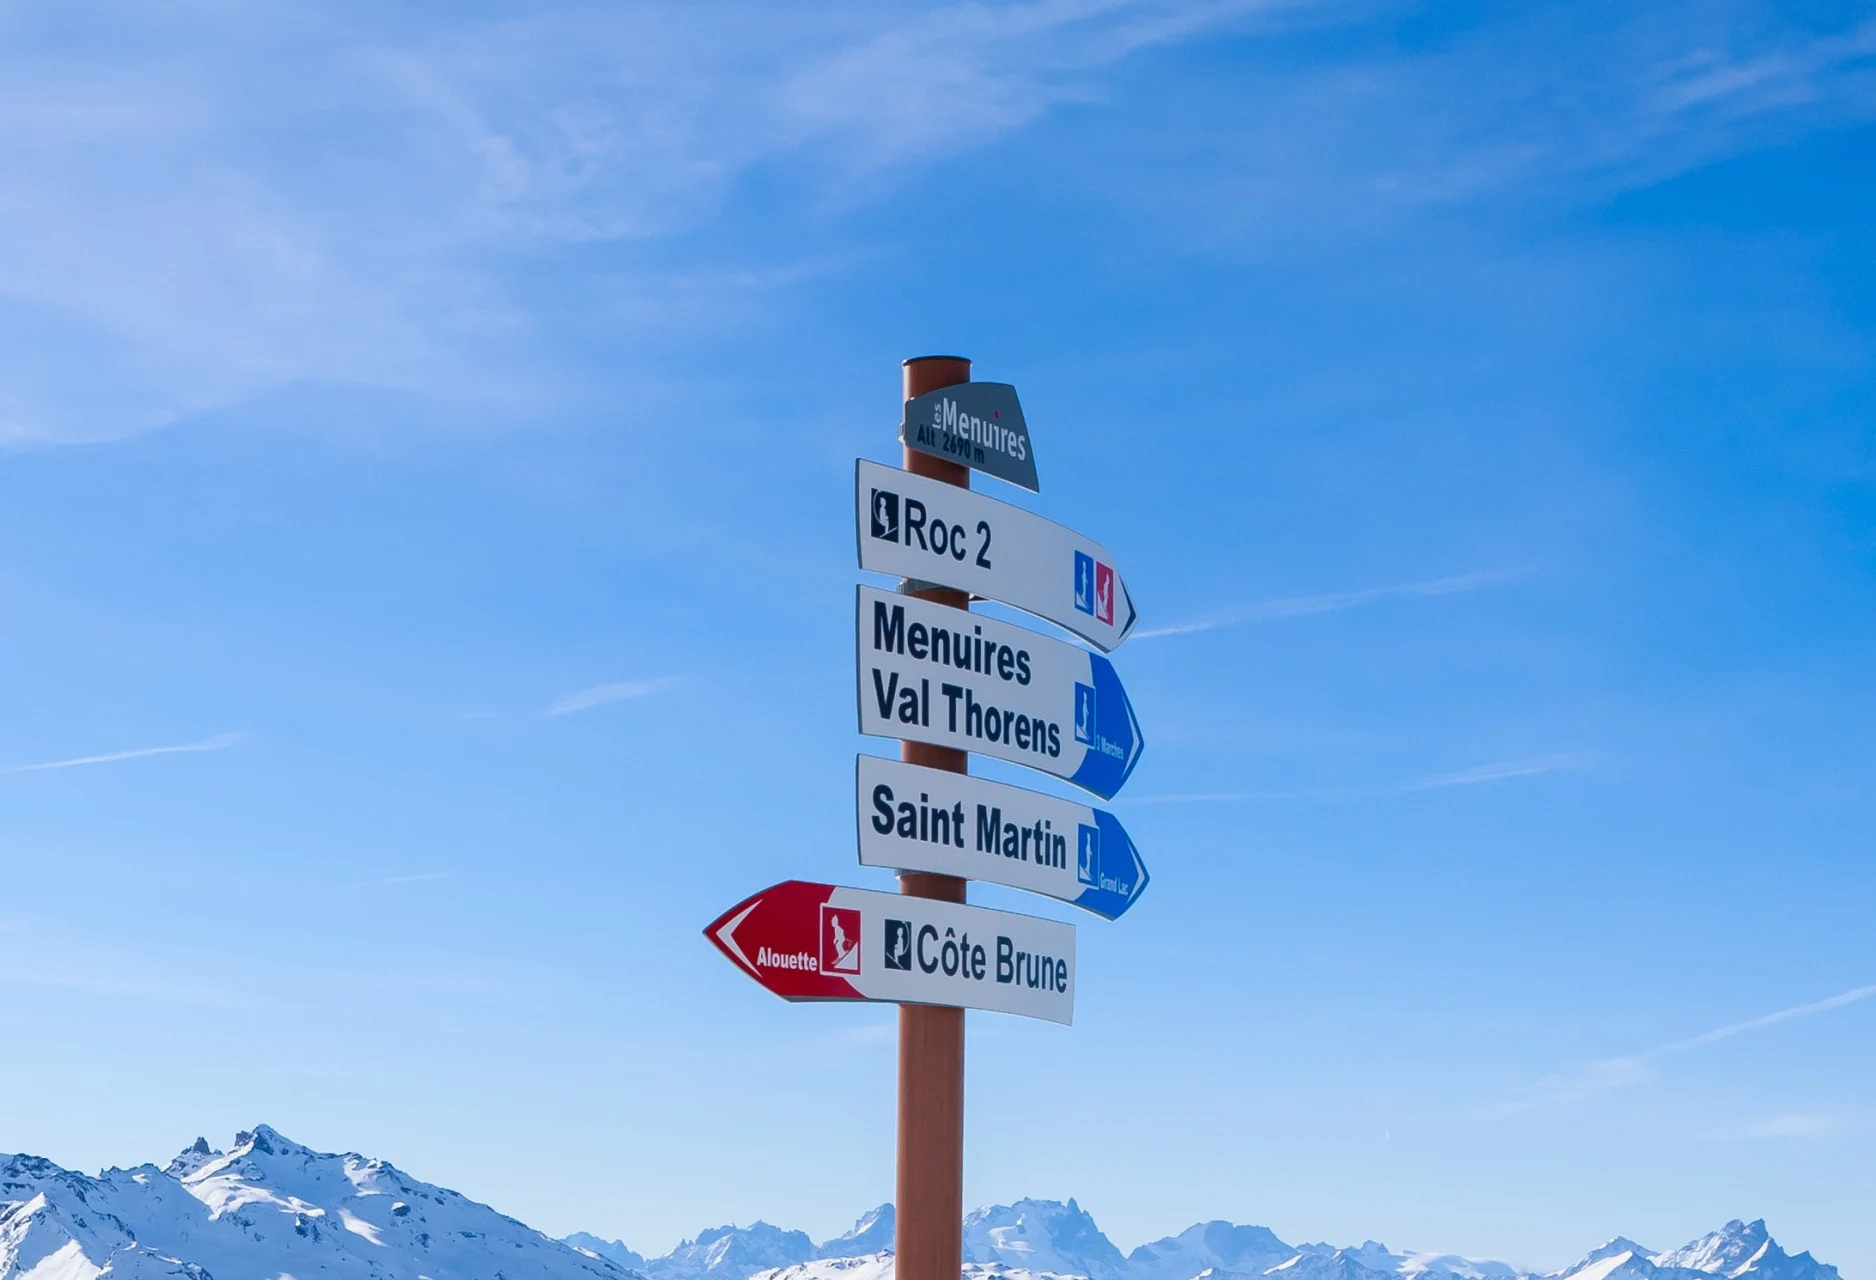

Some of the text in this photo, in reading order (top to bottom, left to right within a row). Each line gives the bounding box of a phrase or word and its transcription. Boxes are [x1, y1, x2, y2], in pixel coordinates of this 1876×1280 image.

[917, 424, 985, 464] Alt 2690 m
[942, 397, 1026, 461] Menuires
[905, 497, 992, 570] Roc 2
[874, 600, 1032, 686] Menuires
[872, 667, 1061, 759] Val Thorens
[871, 783, 1067, 870] Saint Martin
[1100, 872, 1129, 897] Grand Lac
[756, 946, 818, 972] Alouette
[916, 923, 1068, 994] Côte Brune
